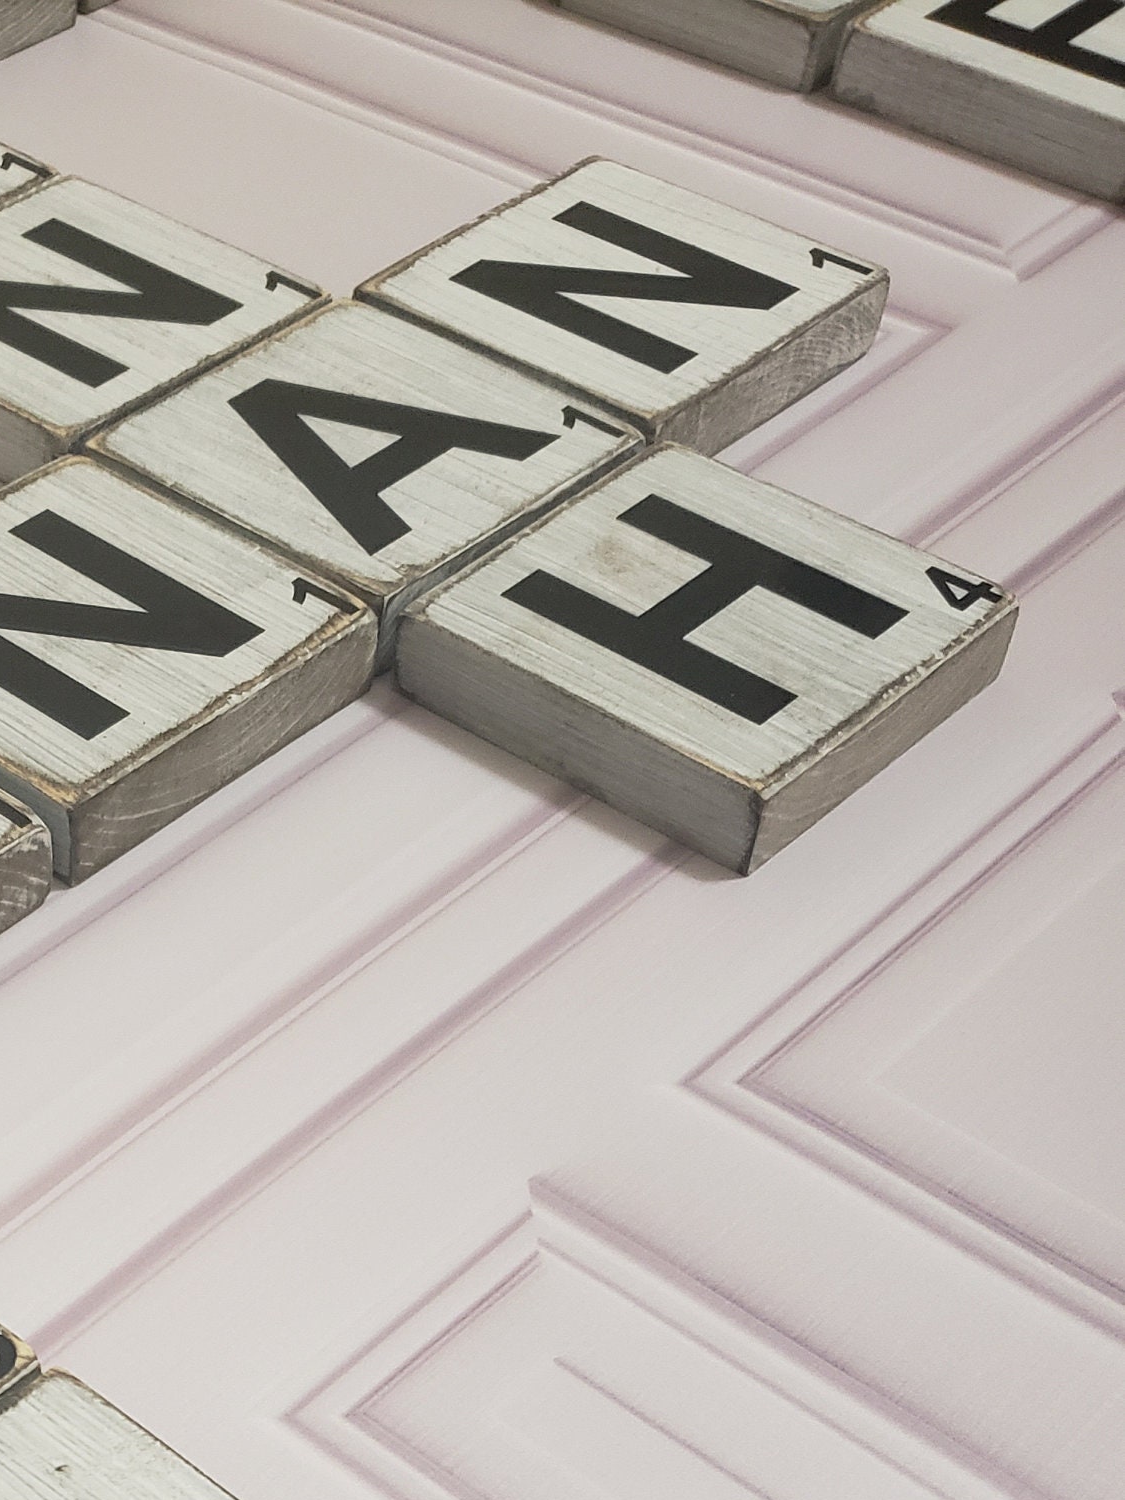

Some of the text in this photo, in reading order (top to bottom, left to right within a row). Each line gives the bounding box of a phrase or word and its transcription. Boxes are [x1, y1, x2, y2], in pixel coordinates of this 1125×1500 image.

[1, 153, 52, 178] 1
[810, 248, 873, 275] 1
[266, 271, 322, 299] 1
[562, 406, 625, 437] 1
[292, 578, 360, 615] 1
[926, 567, 1003, 611] 4
